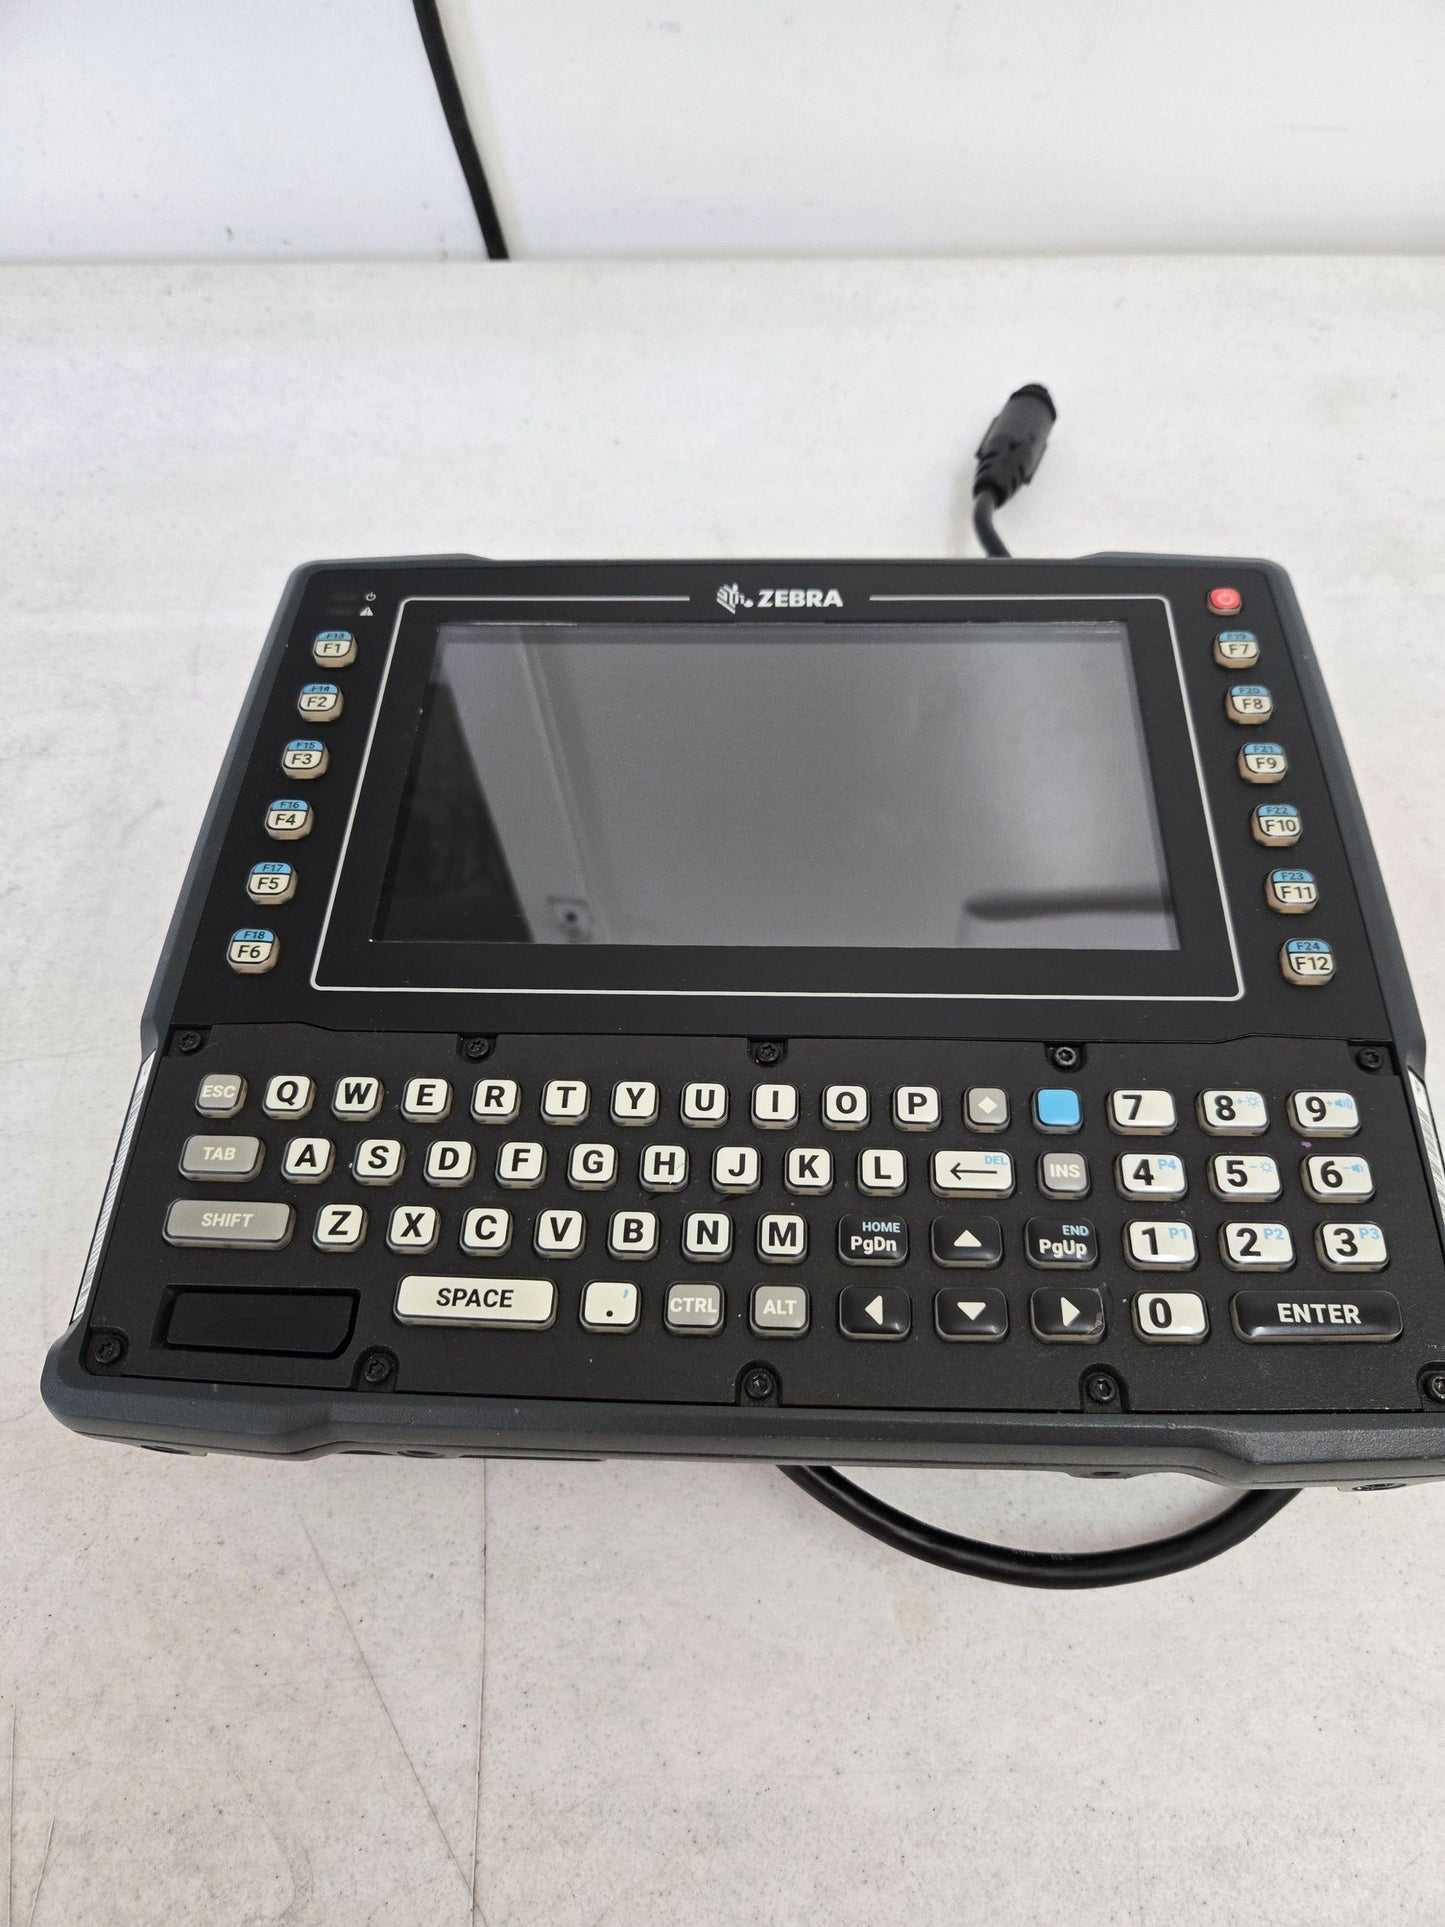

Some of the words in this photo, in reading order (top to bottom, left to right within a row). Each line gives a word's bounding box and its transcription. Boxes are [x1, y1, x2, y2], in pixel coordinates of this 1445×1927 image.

[757, 588, 844, 608] ZEBRA
[323, 643, 341, 653] F1
[1229, 644, 1248, 655] F7
[307, 696, 327, 708] F2
[1242, 699, 1263, 710] F8
[292, 753, 313, 765] F3
[1256, 757, 1277, 769] F9
[280, 801, 300, 809] F16
[1266, 806, 1288, 815] F22
[275, 813, 297, 826] F4
[1265, 819, 1296, 832] F10
[263, 863, 284, 872] F17
[1281, 872, 1304, 880] F23
[257, 876, 280, 890] F5
[1280, 885, 1312, 900] F11
[243, 930, 266, 940] F18
[238, 944, 261, 959] F6
[1297, 941, 1320, 951] F24
[1295, 956, 1330, 971] F12
[201, 1085, 236, 1098] ESC
[276, 1081, 299, 1106] Q
[344, 1083, 371, 1104] W
[416, 1085, 436, 1106] E
[484, 1085, 505, 1107] R
[556, 1087, 576, 1108] T
[625, 1088, 646, 1109] Y
[695, 1089, 715, 1111] U
[772, 1090, 778, 1112] I
[836, 1092, 857, 1114] O
[908, 1093, 927, 1114] P
[1122, 1095, 1142, 1120] 7
[1214, 1095, 1236, 1121] 8
[1305, 1096, 1327, 1122] 9
[203, 1147, 236, 1160] TAB
[294, 1144, 317, 1167] A
[368, 1146, 390, 1169] S
[438, 1148, 459, 1170] D
[511, 1149, 530, 1172] F
[582, 1150, 603, 1173] G
[653, 1152, 676, 1175] H
[985, 1155, 1007, 1165] DEL
[728, 1153, 746, 1177] J
[799, 1155, 819, 1178] K
[874, 1156, 891, 1179] L
[1050, 1164, 1080, 1177] INS
[1132, 1159, 1154, 1185] 4
[1158, 1159, 1176, 1170] P4
[1227, 1160, 1248, 1187] 5
[1320, 1161, 1343, 1188] 6
[201, 1213, 254, 1228] SHIFT
[328, 1211, 352, 1235] Z
[401, 1212, 425, 1237] X
[475, 1215, 498, 1240] C
[550, 1217, 573, 1241] V
[623, 1218, 643, 1243] B
[862, 1222, 900, 1233] HOME
[1062, 1225, 1089, 1236] END
[696, 1220, 719, 1244] N
[768, 1221, 797, 1246] M
[1141, 1227, 1158, 1255] 1
[1168, 1228, 1188, 1238] P1
[1236, 1228, 1261, 1256] 2
[1263, 1228, 1284, 1240] P2
[1333, 1229, 1358, 1256] 3
[1359, 1228, 1380, 1239] P3
[851, 1236, 897, 1253] PgDn
[1039, 1239, 1088, 1257] PgUp
[436, 1288, 514, 1308] SPACE
[670, 1298, 718, 1313] CTRL
[763, 1300, 797, 1314] ALT
[1148, 1297, 1172, 1329] 0
[1277, 1303, 1361, 1324] ENTER
